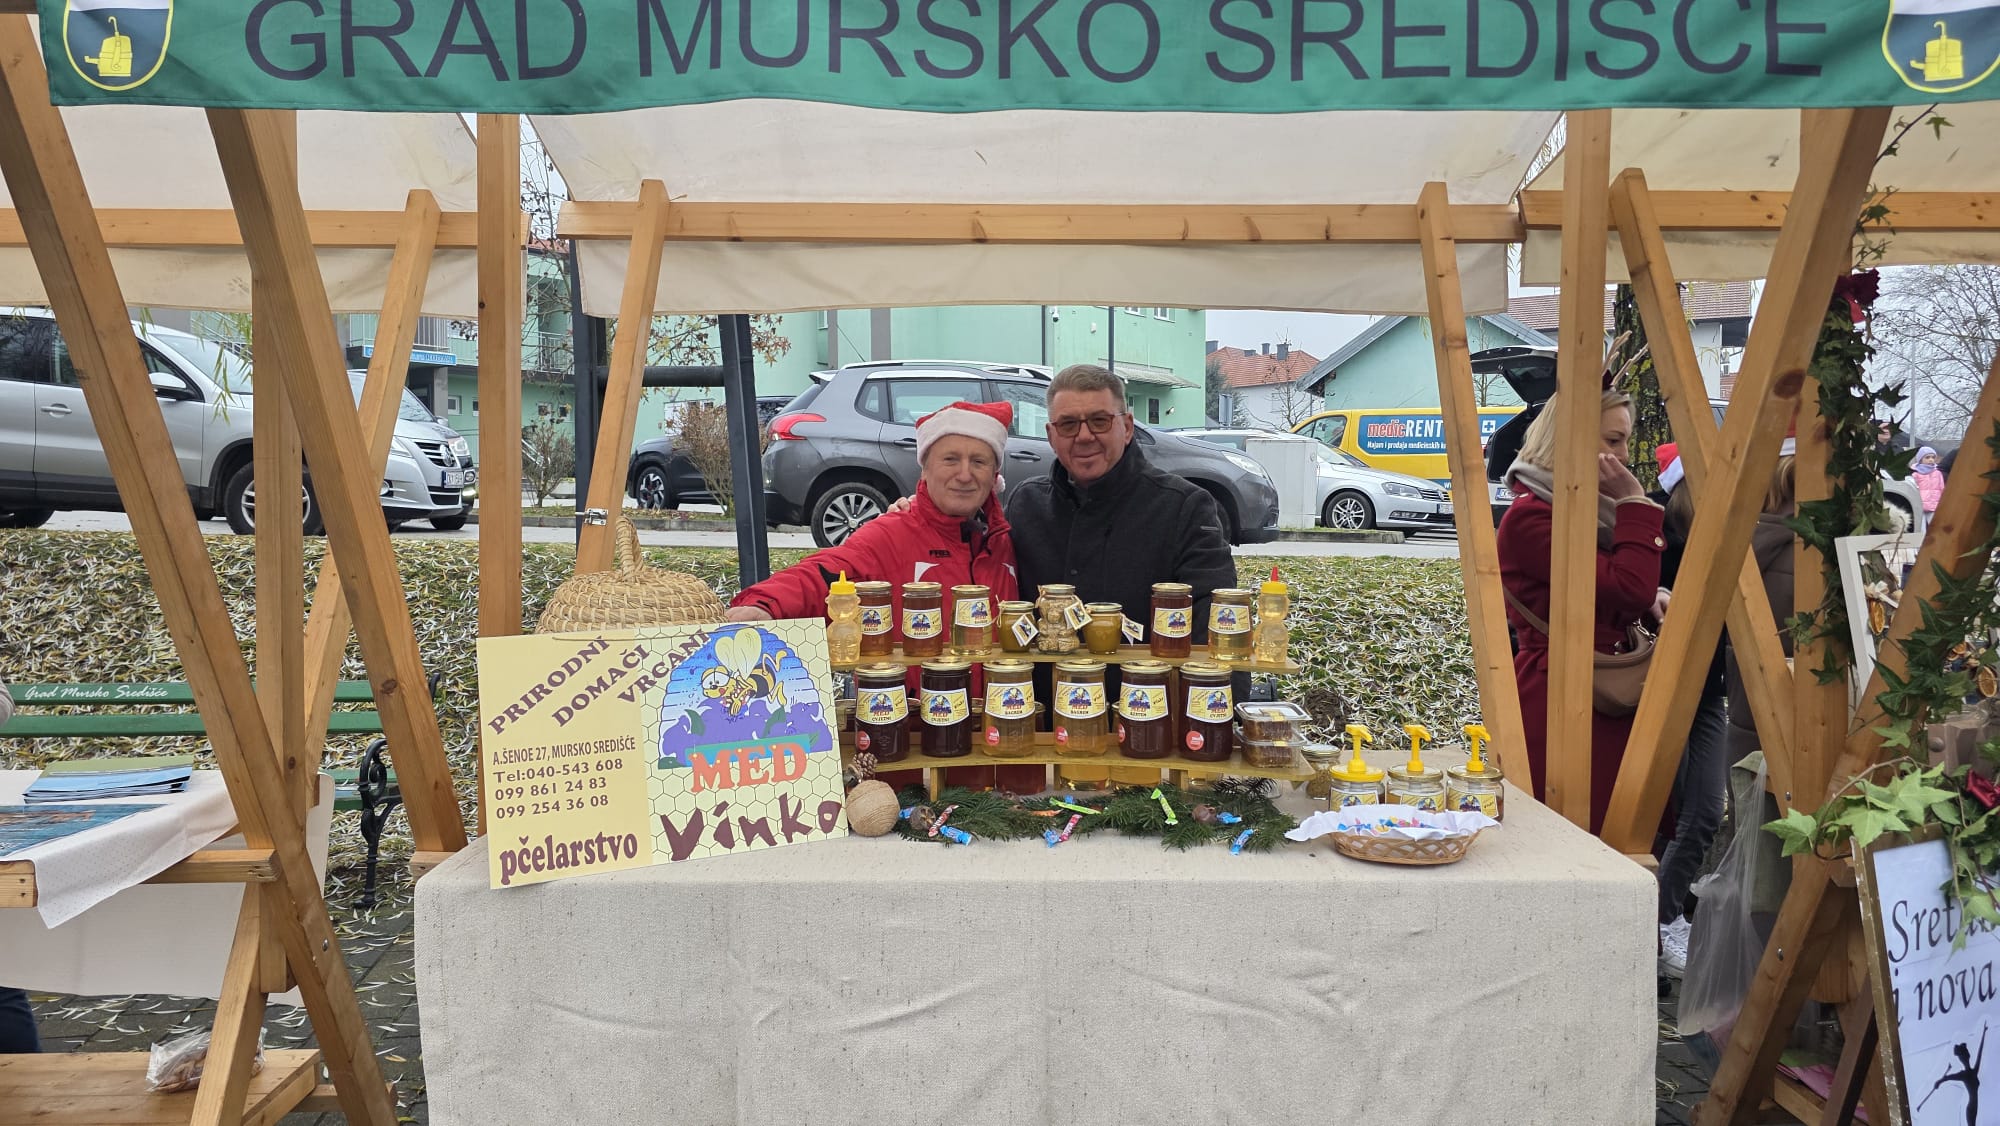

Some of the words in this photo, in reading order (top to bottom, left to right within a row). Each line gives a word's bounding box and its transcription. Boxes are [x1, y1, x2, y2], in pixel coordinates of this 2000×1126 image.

[245, 0, 587, 81] GRAD
[637, 0, 1160, 83] MURSKO
[25, 685, 57, 700] Grad
[60, 686, 109, 698] Mursko
[114, 685, 168, 699] Središće
[488, 635, 612, 734] PRIRODNI
[551, 644, 651, 728] DOMAČI
[616, 629, 712, 704] VRCANI
[493, 747, 534, 766] A.ŠENOE
[536, 746, 551, 763] 27,
[551, 743, 592, 759] MURSKO
[593, 736, 637, 754] SREDIŠĆE
[493, 763, 589, 784] Tel:040-543
[596, 758, 623, 772] 608
[688, 742, 808, 794] MED
[495, 787, 526, 801] 099
[529, 783, 557, 798] 861
[564, 780, 584, 794] 24
[587, 777, 607, 790] 83
[496, 806, 528, 820] 099
[531, 800, 561, 816] 254
[566, 798, 585, 811] 36
[589, 794, 609, 808] 08
[660, 792, 842, 861] Vinko
[500, 831, 638, 885] pčelarstvo
[1914, 960, 1997, 1021] nova
